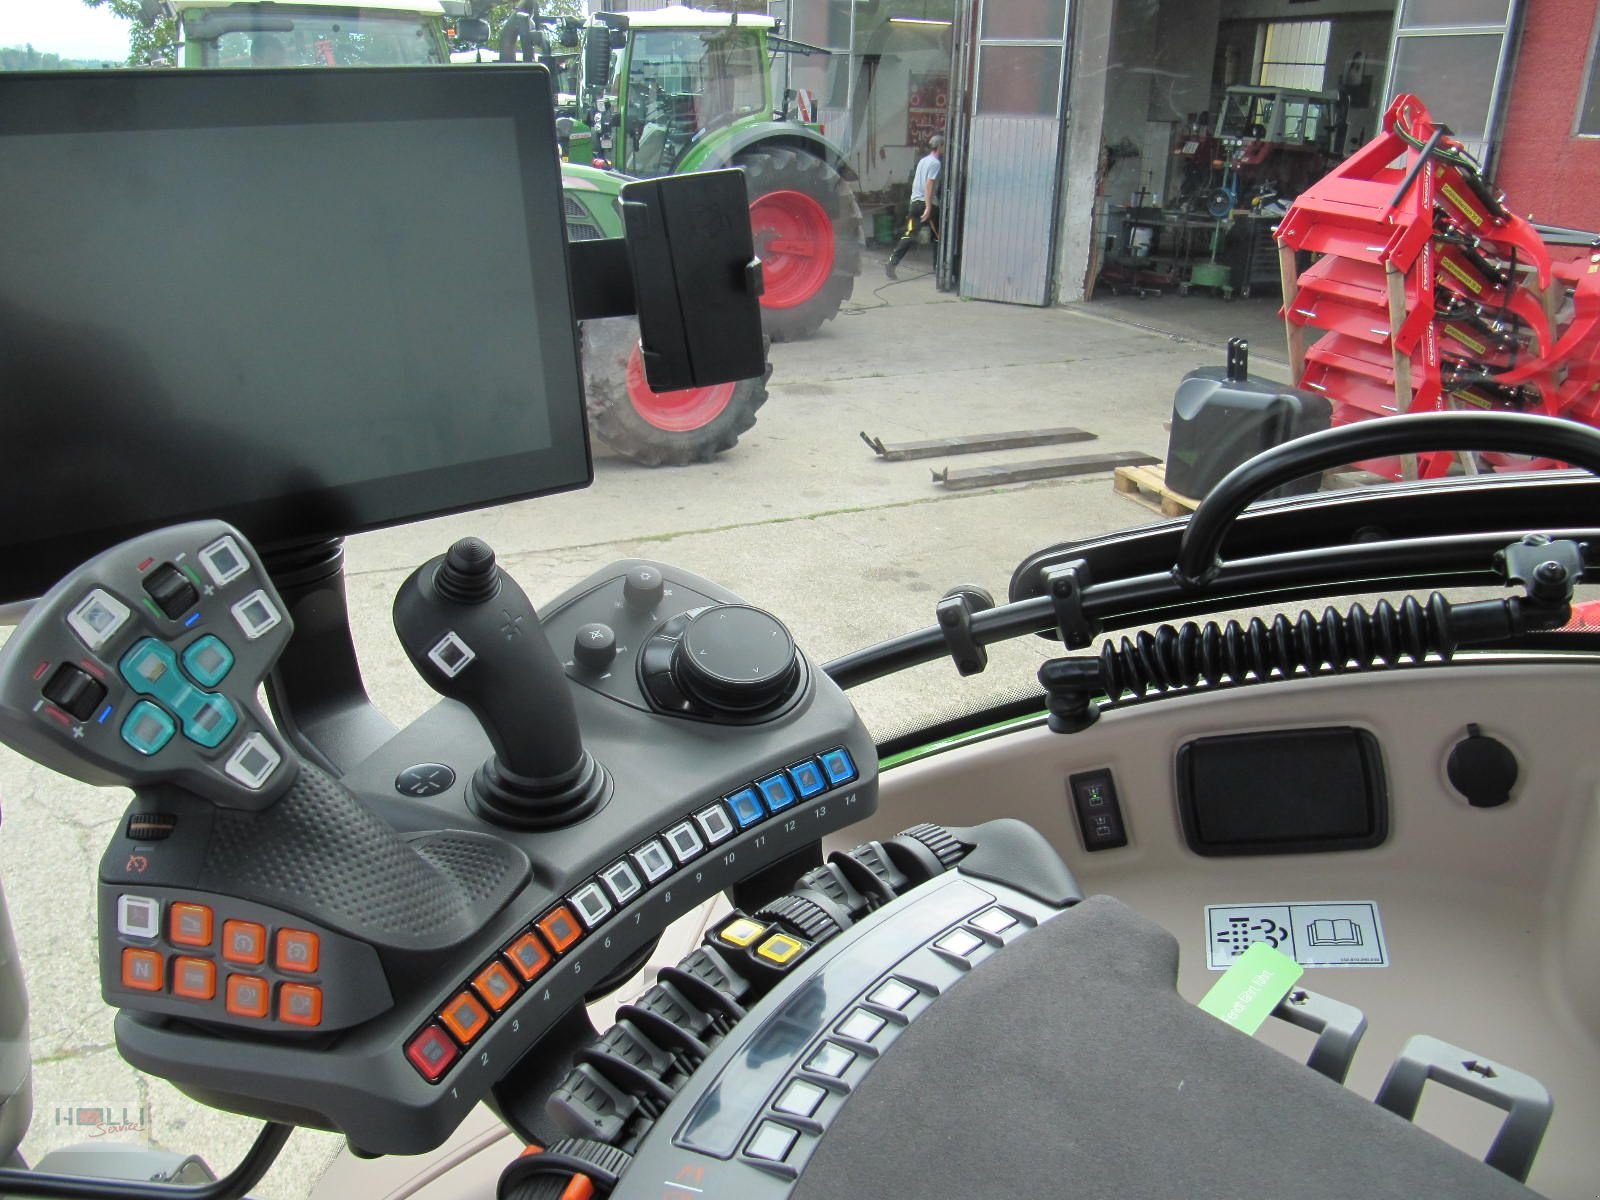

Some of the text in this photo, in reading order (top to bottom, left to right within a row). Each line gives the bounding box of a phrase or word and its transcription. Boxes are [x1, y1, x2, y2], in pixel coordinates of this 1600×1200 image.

[135, 962, 149, 976] N
[451, 793, 857, 1099] 1 2 3 4 5 6 7 8 9 10 11 12 13 14
